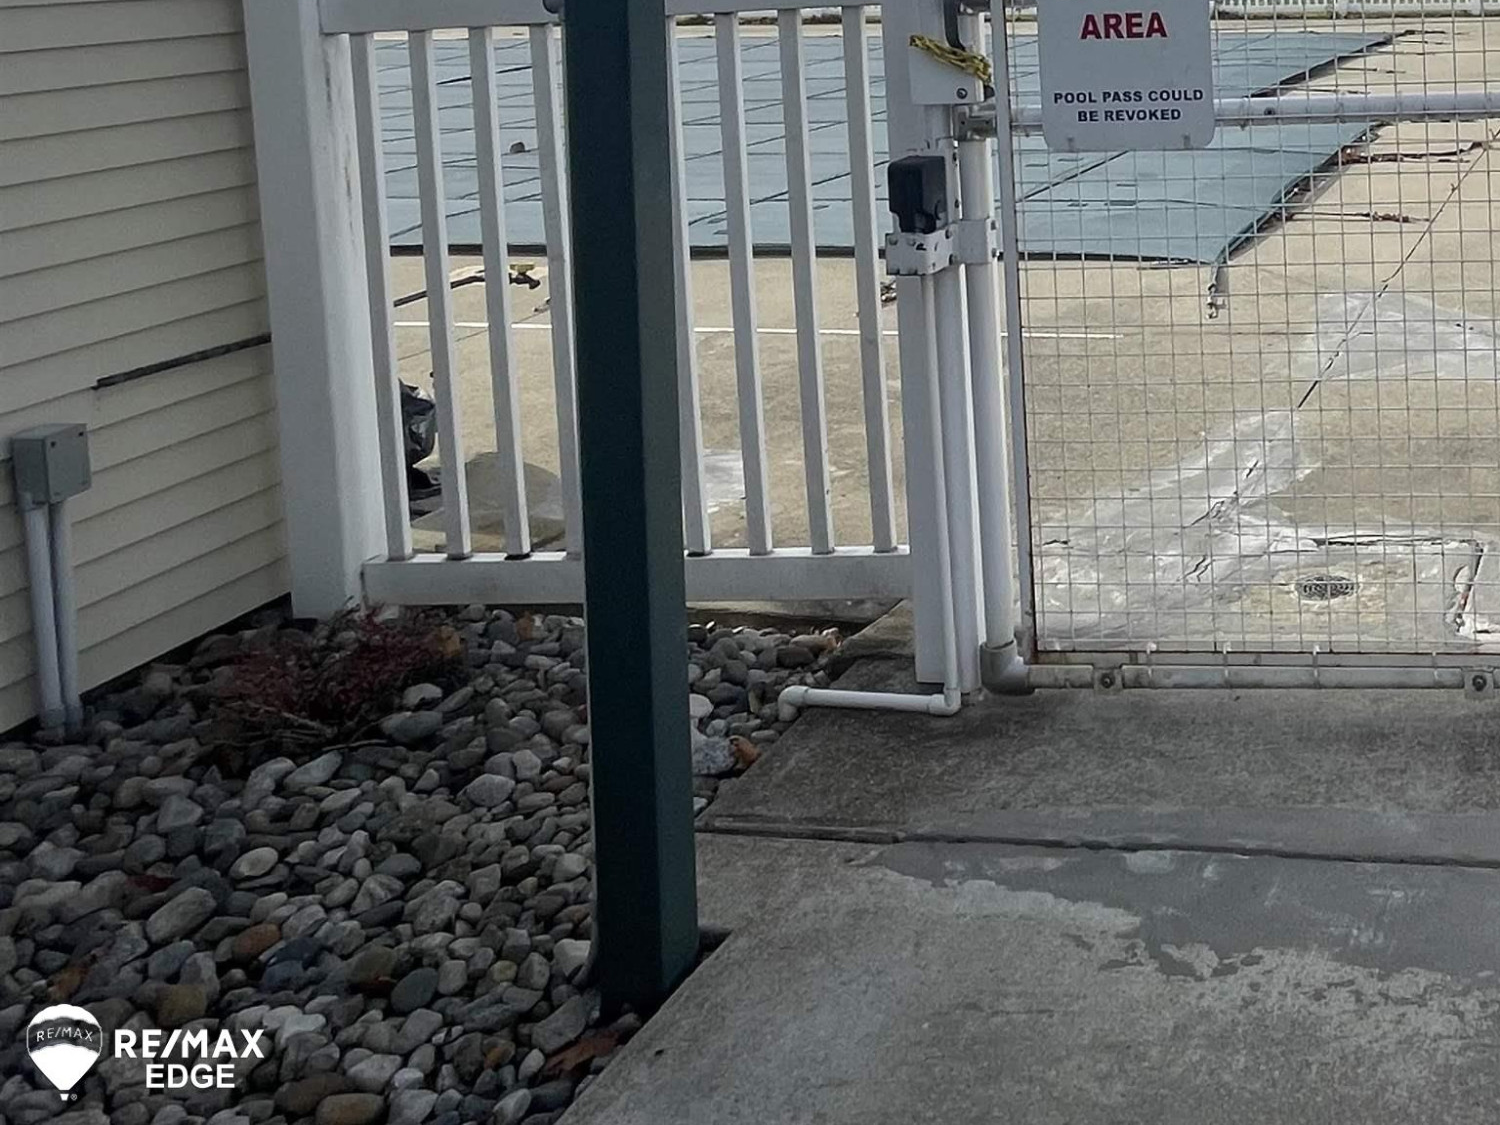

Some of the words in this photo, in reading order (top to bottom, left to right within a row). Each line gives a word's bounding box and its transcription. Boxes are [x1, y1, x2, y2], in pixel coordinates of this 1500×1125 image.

[1080, 12, 1167, 40] AREA
[1053, 92, 1097, 104] POOL
[1102, 91, 1143, 102] PASS
[1148, 89, 1204, 101] COULD
[1077, 111, 1099, 122] BE
[1104, 108, 1181, 121] REVOKED
